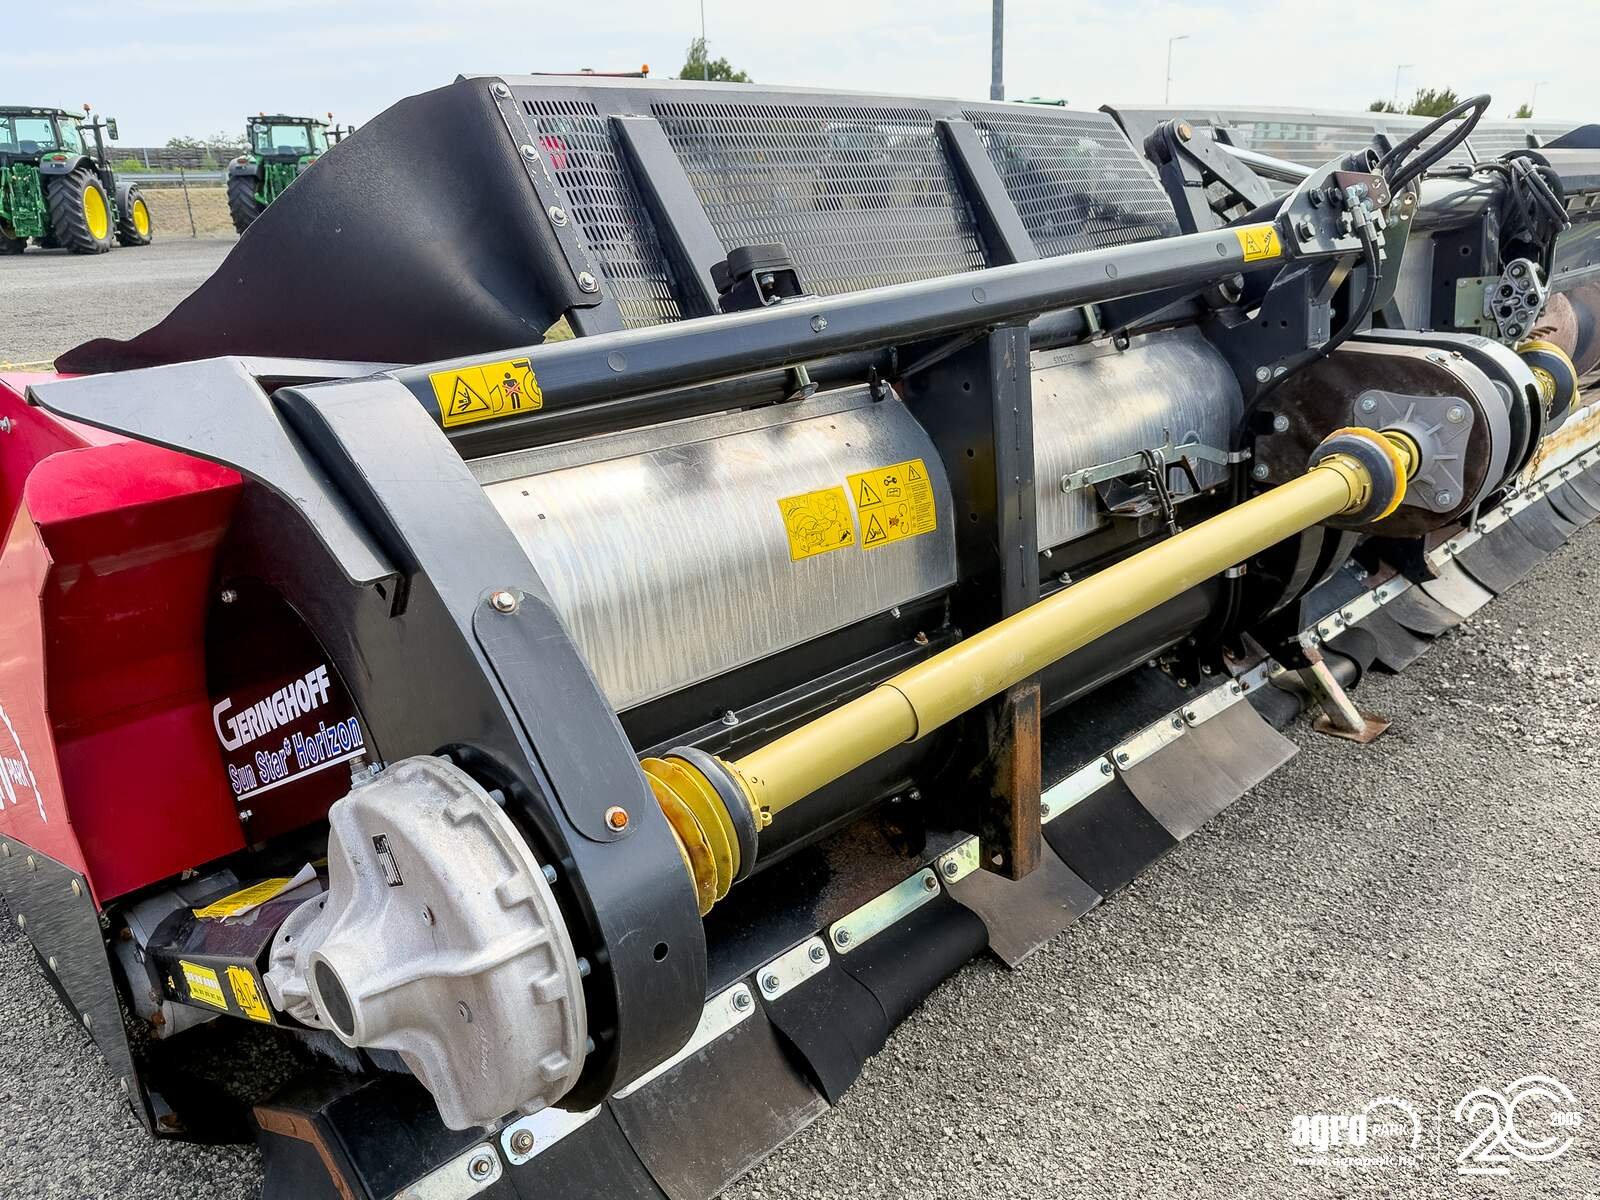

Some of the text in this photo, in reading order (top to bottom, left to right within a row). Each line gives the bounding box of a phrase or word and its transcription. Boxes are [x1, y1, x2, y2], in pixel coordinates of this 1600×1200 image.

[213, 664, 331, 752] GERINGHOFF
[228, 763, 257, 794] Sun
[291, 716, 364, 769] Horizon
